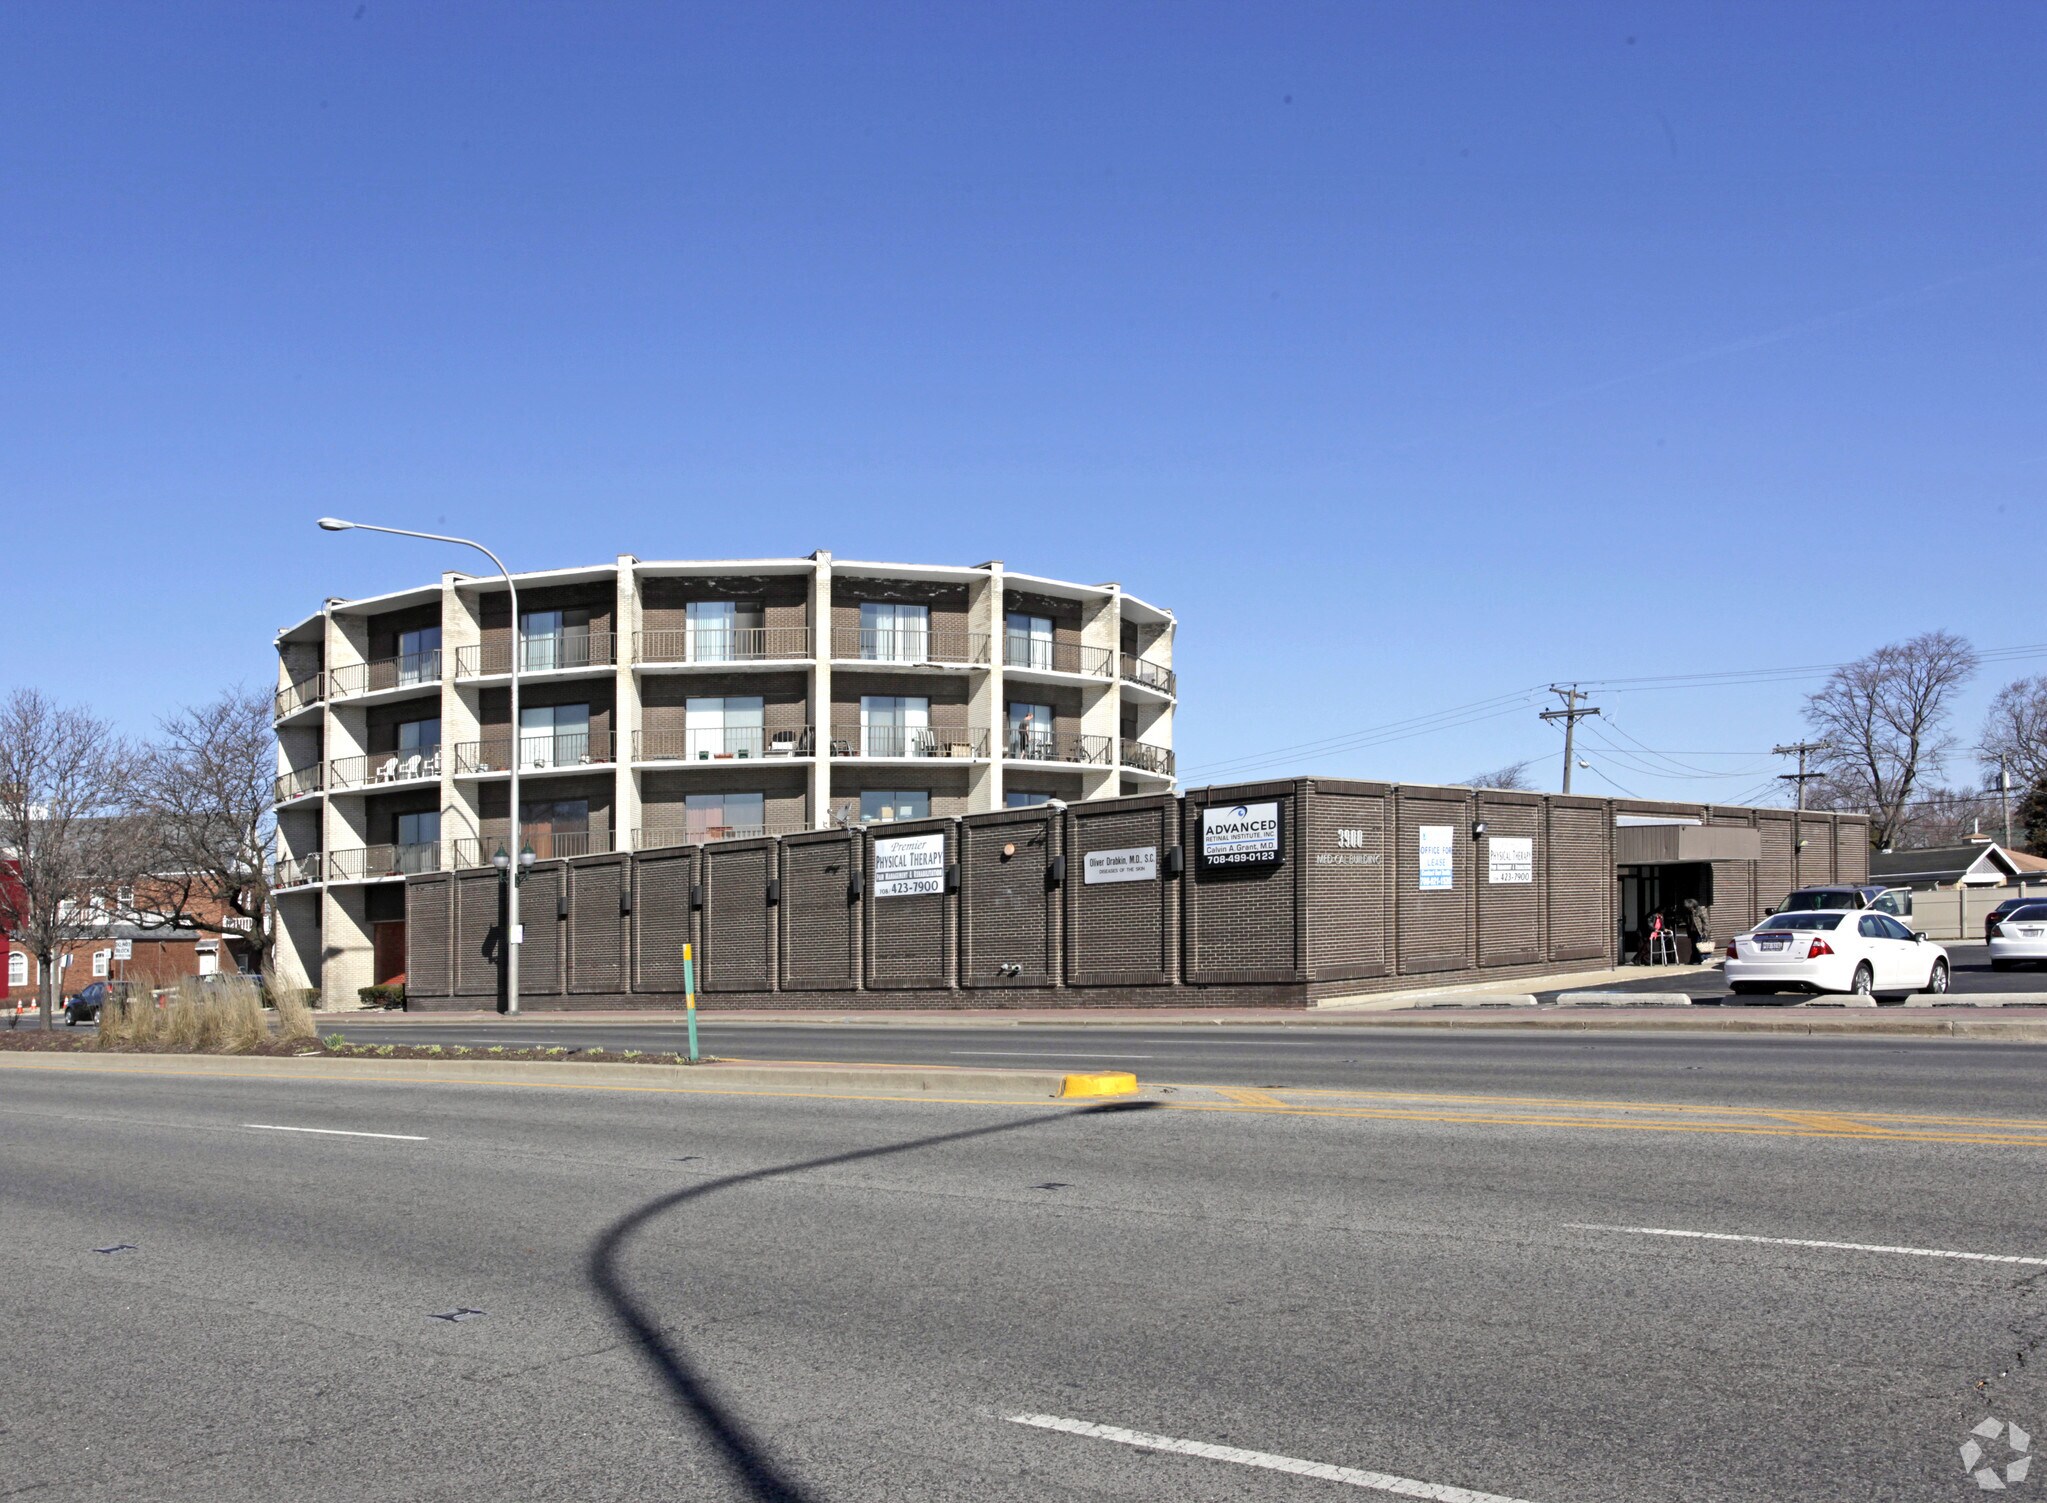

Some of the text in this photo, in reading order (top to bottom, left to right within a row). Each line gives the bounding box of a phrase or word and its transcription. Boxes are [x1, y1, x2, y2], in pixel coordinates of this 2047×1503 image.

[1206, 820, 1276, 835] ADVANCED
[1337, 829, 1363, 848] 3900
[891, 840, 927, 852] Premier
[1206, 846, 1227, 854] Calvin
[1420, 846, 1440, 855] OFFICE
[876, 852, 943, 869] PHYSICAL THERAPY
[1090, 857, 1105, 868] Oliver
[1208, 852, 1275, 864] 708-499-0123
[1427, 858, 1446, 867] LEASE
[1500, 872, 1530, 881] 423-7900
[892, 880, 939, 894] 423-7900
